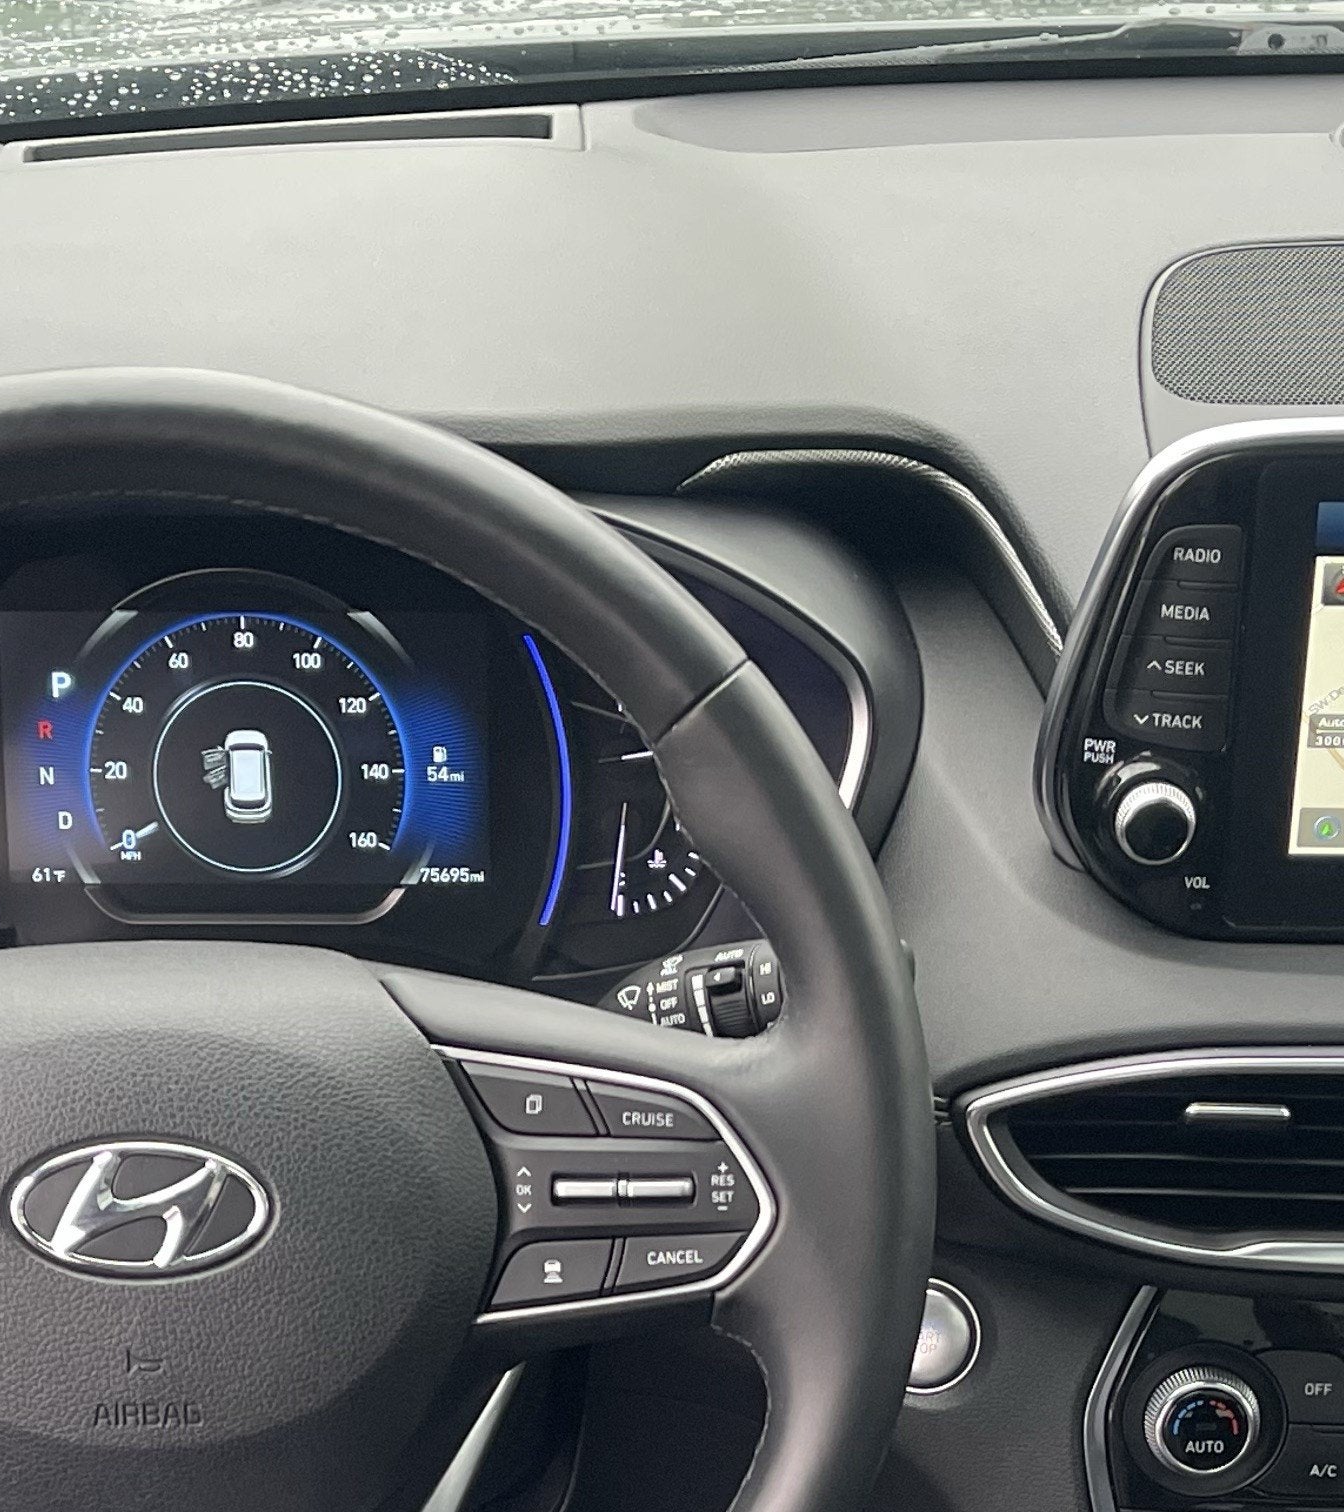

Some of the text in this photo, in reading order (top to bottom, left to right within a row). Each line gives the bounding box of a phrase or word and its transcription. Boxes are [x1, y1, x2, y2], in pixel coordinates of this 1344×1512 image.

[1173, 547, 1221, 563] RADIO
[1161, 604, 1210, 621] MEDIA
[233, 631, 254, 649] 80
[169, 653, 188, 669] 60
[292, 652, 322, 670] 100
[1164, 660, 1205, 676] SEEK
[50, 672, 71, 698] P
[122, 697, 143, 714] 40
[338, 696, 367, 715] 120
[1152, 714, 1203, 729] TRACK
[38, 722, 52, 738] R
[1084, 738, 1116, 754] PWR
[1084, 752, 1114, 764] PUSH
[39, 767, 54, 784] N
[104, 762, 127, 780] 20
[361, 762, 389, 781] 140
[58, 812, 72, 829] D
[122, 830, 136, 850] 0
[349, 831, 378, 849] 160
[1184, 876, 1210, 889] VOL
[759, 961, 772, 976] HI
[660, 996, 678, 1011] OFF
[761, 991, 776, 1005] LO
[660, 1013, 686, 1027] AUTO
[622, 1111, 674, 1128] CRUISE
[711, 1174, 734, 1187] RES
[516, 1183, 532, 1196] OK
[711, 1190, 733, 1204] SET
[647, 1250, 704, 1266] CANCEL
[1304, 1383, 1333, 1396] OFF
[93, 1402, 203, 1428] AIRBAG
[1185, 1440, 1225, 1454] AUTO
[1309, 1464, 1337, 1478] A/C
